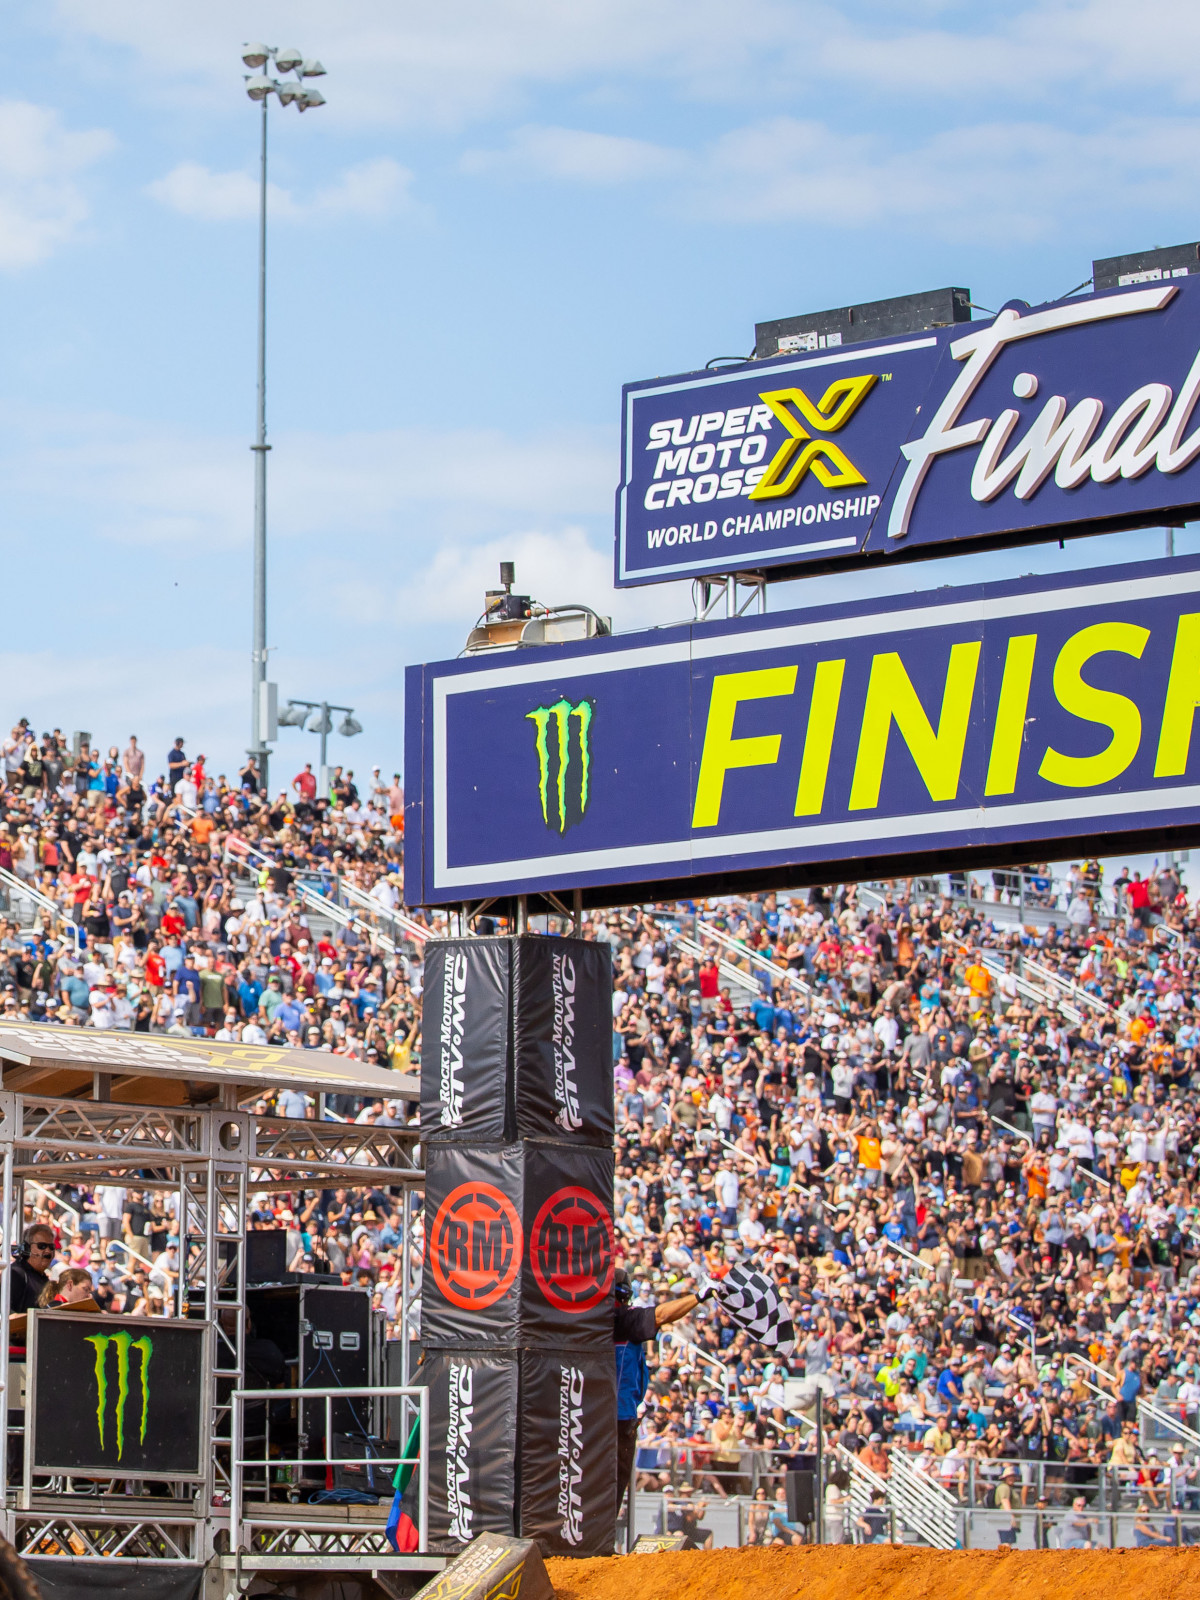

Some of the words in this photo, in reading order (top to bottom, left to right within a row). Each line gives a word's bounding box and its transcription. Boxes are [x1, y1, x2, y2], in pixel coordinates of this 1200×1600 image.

[645, 403, 774, 450] SUPER
[653, 434, 768, 480] MOTO
[643, 464, 770, 511] CROSS
[646, 520, 718, 549] WORLD
[721, 494, 881, 537] CHAMPIONSHIP
[439, 952, 456, 1047] MOUNTAIN
[551, 952, 564, 1047] MOUNTAIN
[439, 1048, 450, 1103] ROCKY
[554, 1048, 566, 1104] ROCKY
[447, 1220, 501, 1273] RM
[547, 1225, 604, 1277] RM
[445, 1362, 461, 1456] MOUNTAIN
[558, 1365, 572, 1459] MOUNTAIN
[446, 1457, 459, 1516] ROCKY
[557, 1459, 571, 1519] ROCKY
